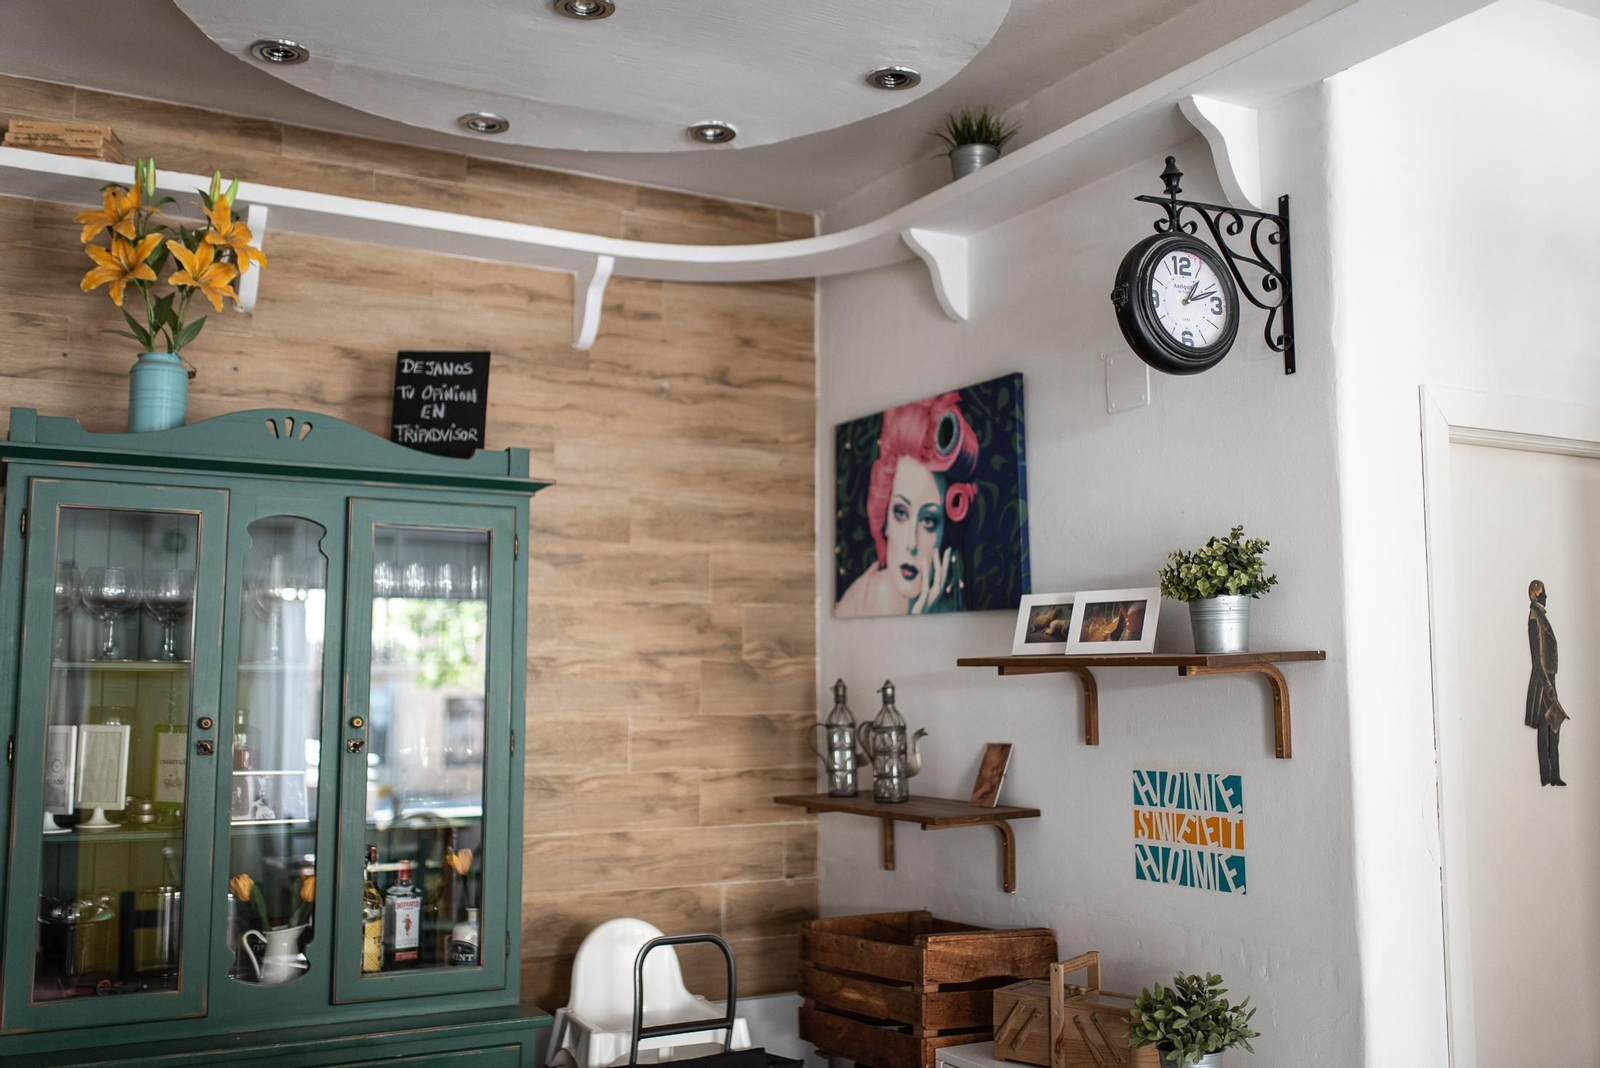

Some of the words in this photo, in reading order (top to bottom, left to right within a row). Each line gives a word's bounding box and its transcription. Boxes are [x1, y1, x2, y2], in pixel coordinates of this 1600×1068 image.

[1171, 255, 1192, 277] 12
[1151, 289, 1160, 309] 9
[1210, 296, 1223, 316] 3
[1181, 330, 1195, 348] 6
[400, 358, 474, 376] DEJANOS
[420, 402, 446, 419] EN
[1132, 769, 1244, 814] HOME
[1133, 809, 1245, 851] SWEET
[1134, 843, 1247, 896] HOME
